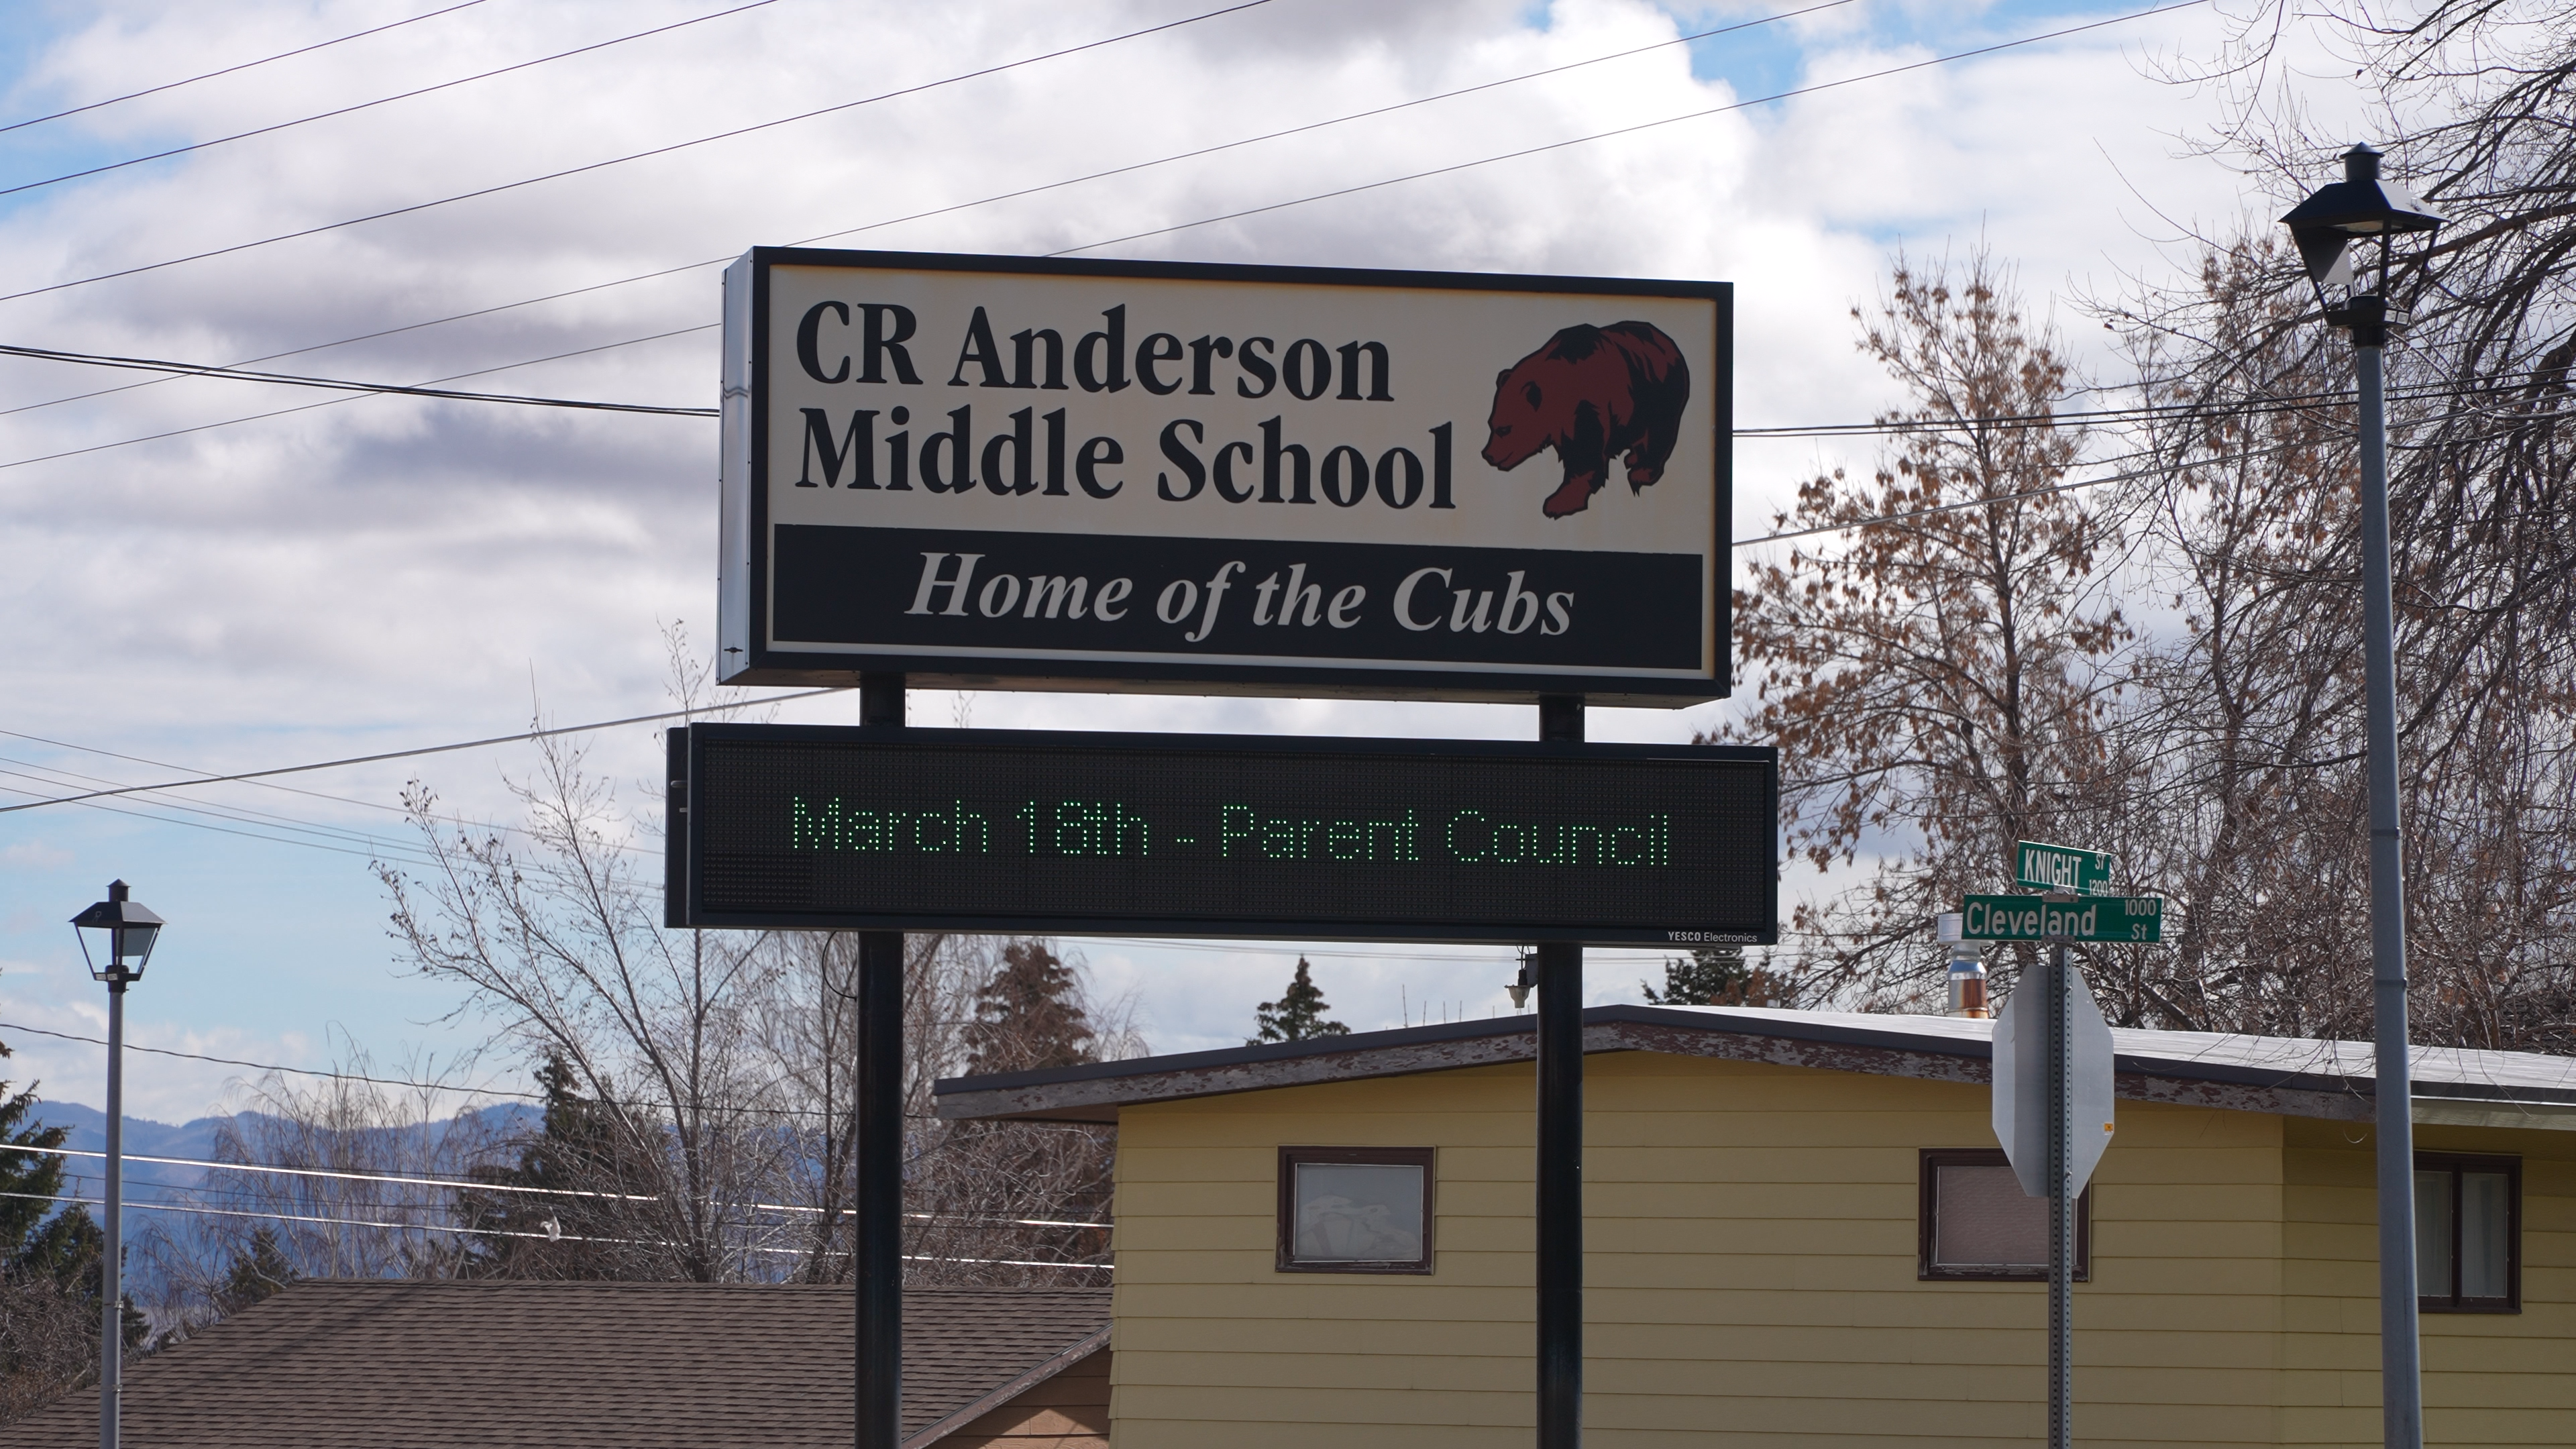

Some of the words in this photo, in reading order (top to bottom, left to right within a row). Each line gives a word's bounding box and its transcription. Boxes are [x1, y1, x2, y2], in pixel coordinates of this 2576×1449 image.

[796, 300, 924, 386] CR
[947, 303, 1395, 402] Anderson
[794, 403, 1124, 500] Middle
[1157, 415, 1456, 510] School
[904, 552, 1132, 624] Home
[1157, 561, 1246, 642] of
[1253, 563, 1366, 629] the
[1393, 568, 1574, 635] Cubs
[794, 796, 987, 853] March
[1222, 805, 1419, 861] Parent
[1447, 810, 1668, 866] Council
[2024, 849, 2082, 888] KNIGHT
[2095, 854, 2106, 870] ST
[2089, 879, 2108, 896] 1200
[1966, 902, 2096, 936] Cleveland
[2124, 899, 2157, 916] 1000
[1668, 931, 1701, 941] YESCO
[1703, 932, 1758, 943] Electronics
[2131, 923, 2147, 941] St
